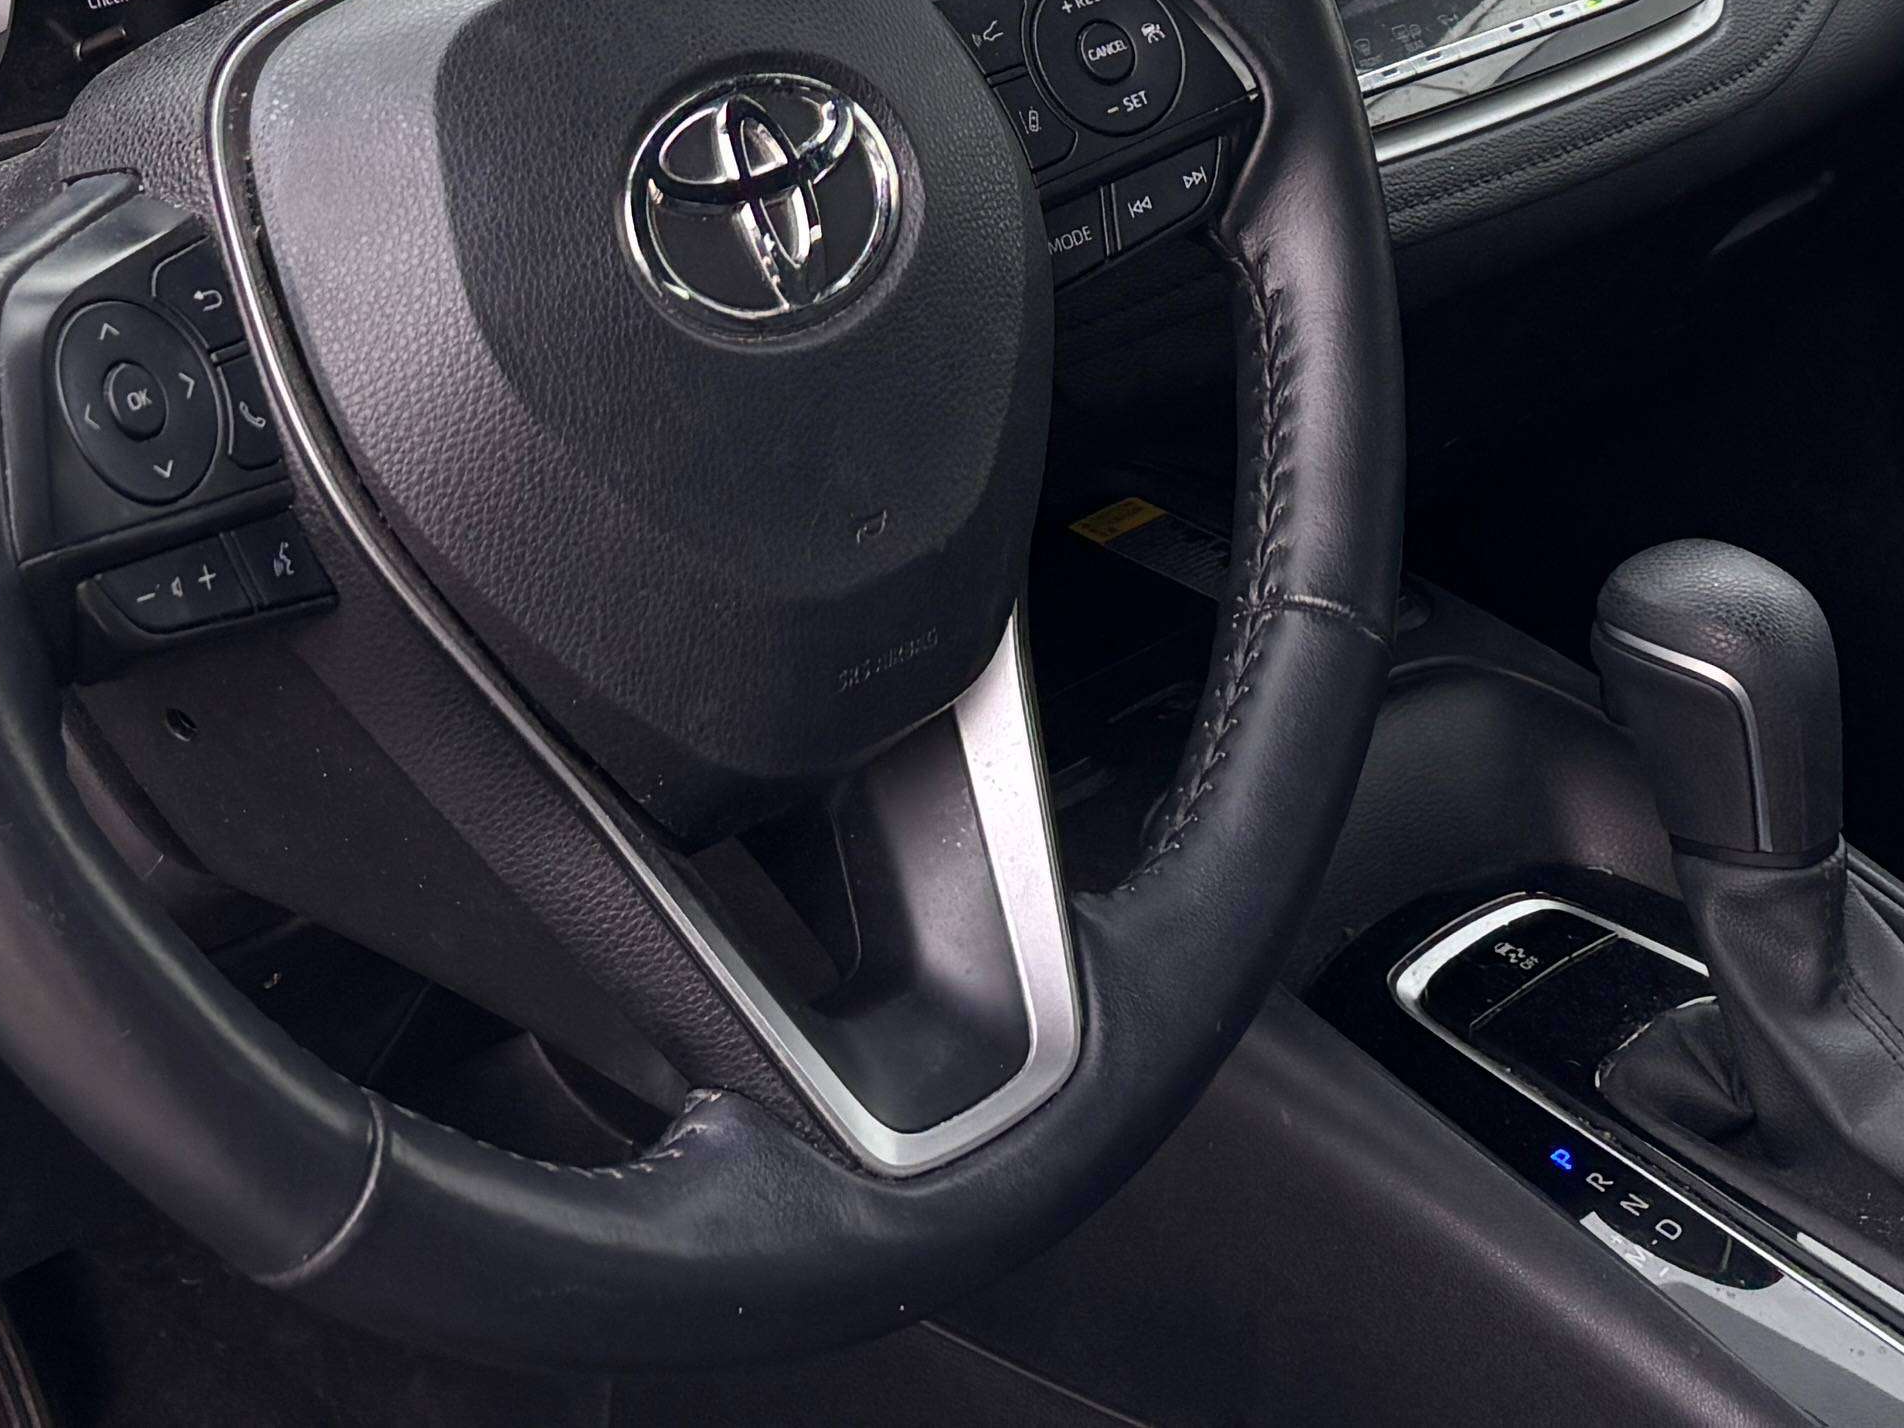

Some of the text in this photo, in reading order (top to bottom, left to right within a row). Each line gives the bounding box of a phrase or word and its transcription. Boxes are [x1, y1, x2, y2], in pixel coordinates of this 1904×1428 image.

[1087, 39, 1129, 62] CANCEL
[1122, 89, 1149, 114] SET
[1047, 224, 1094, 256] MODE
[127, 388, 152, 412] OK
[1550, 1148, 1683, 1240] P R N D
